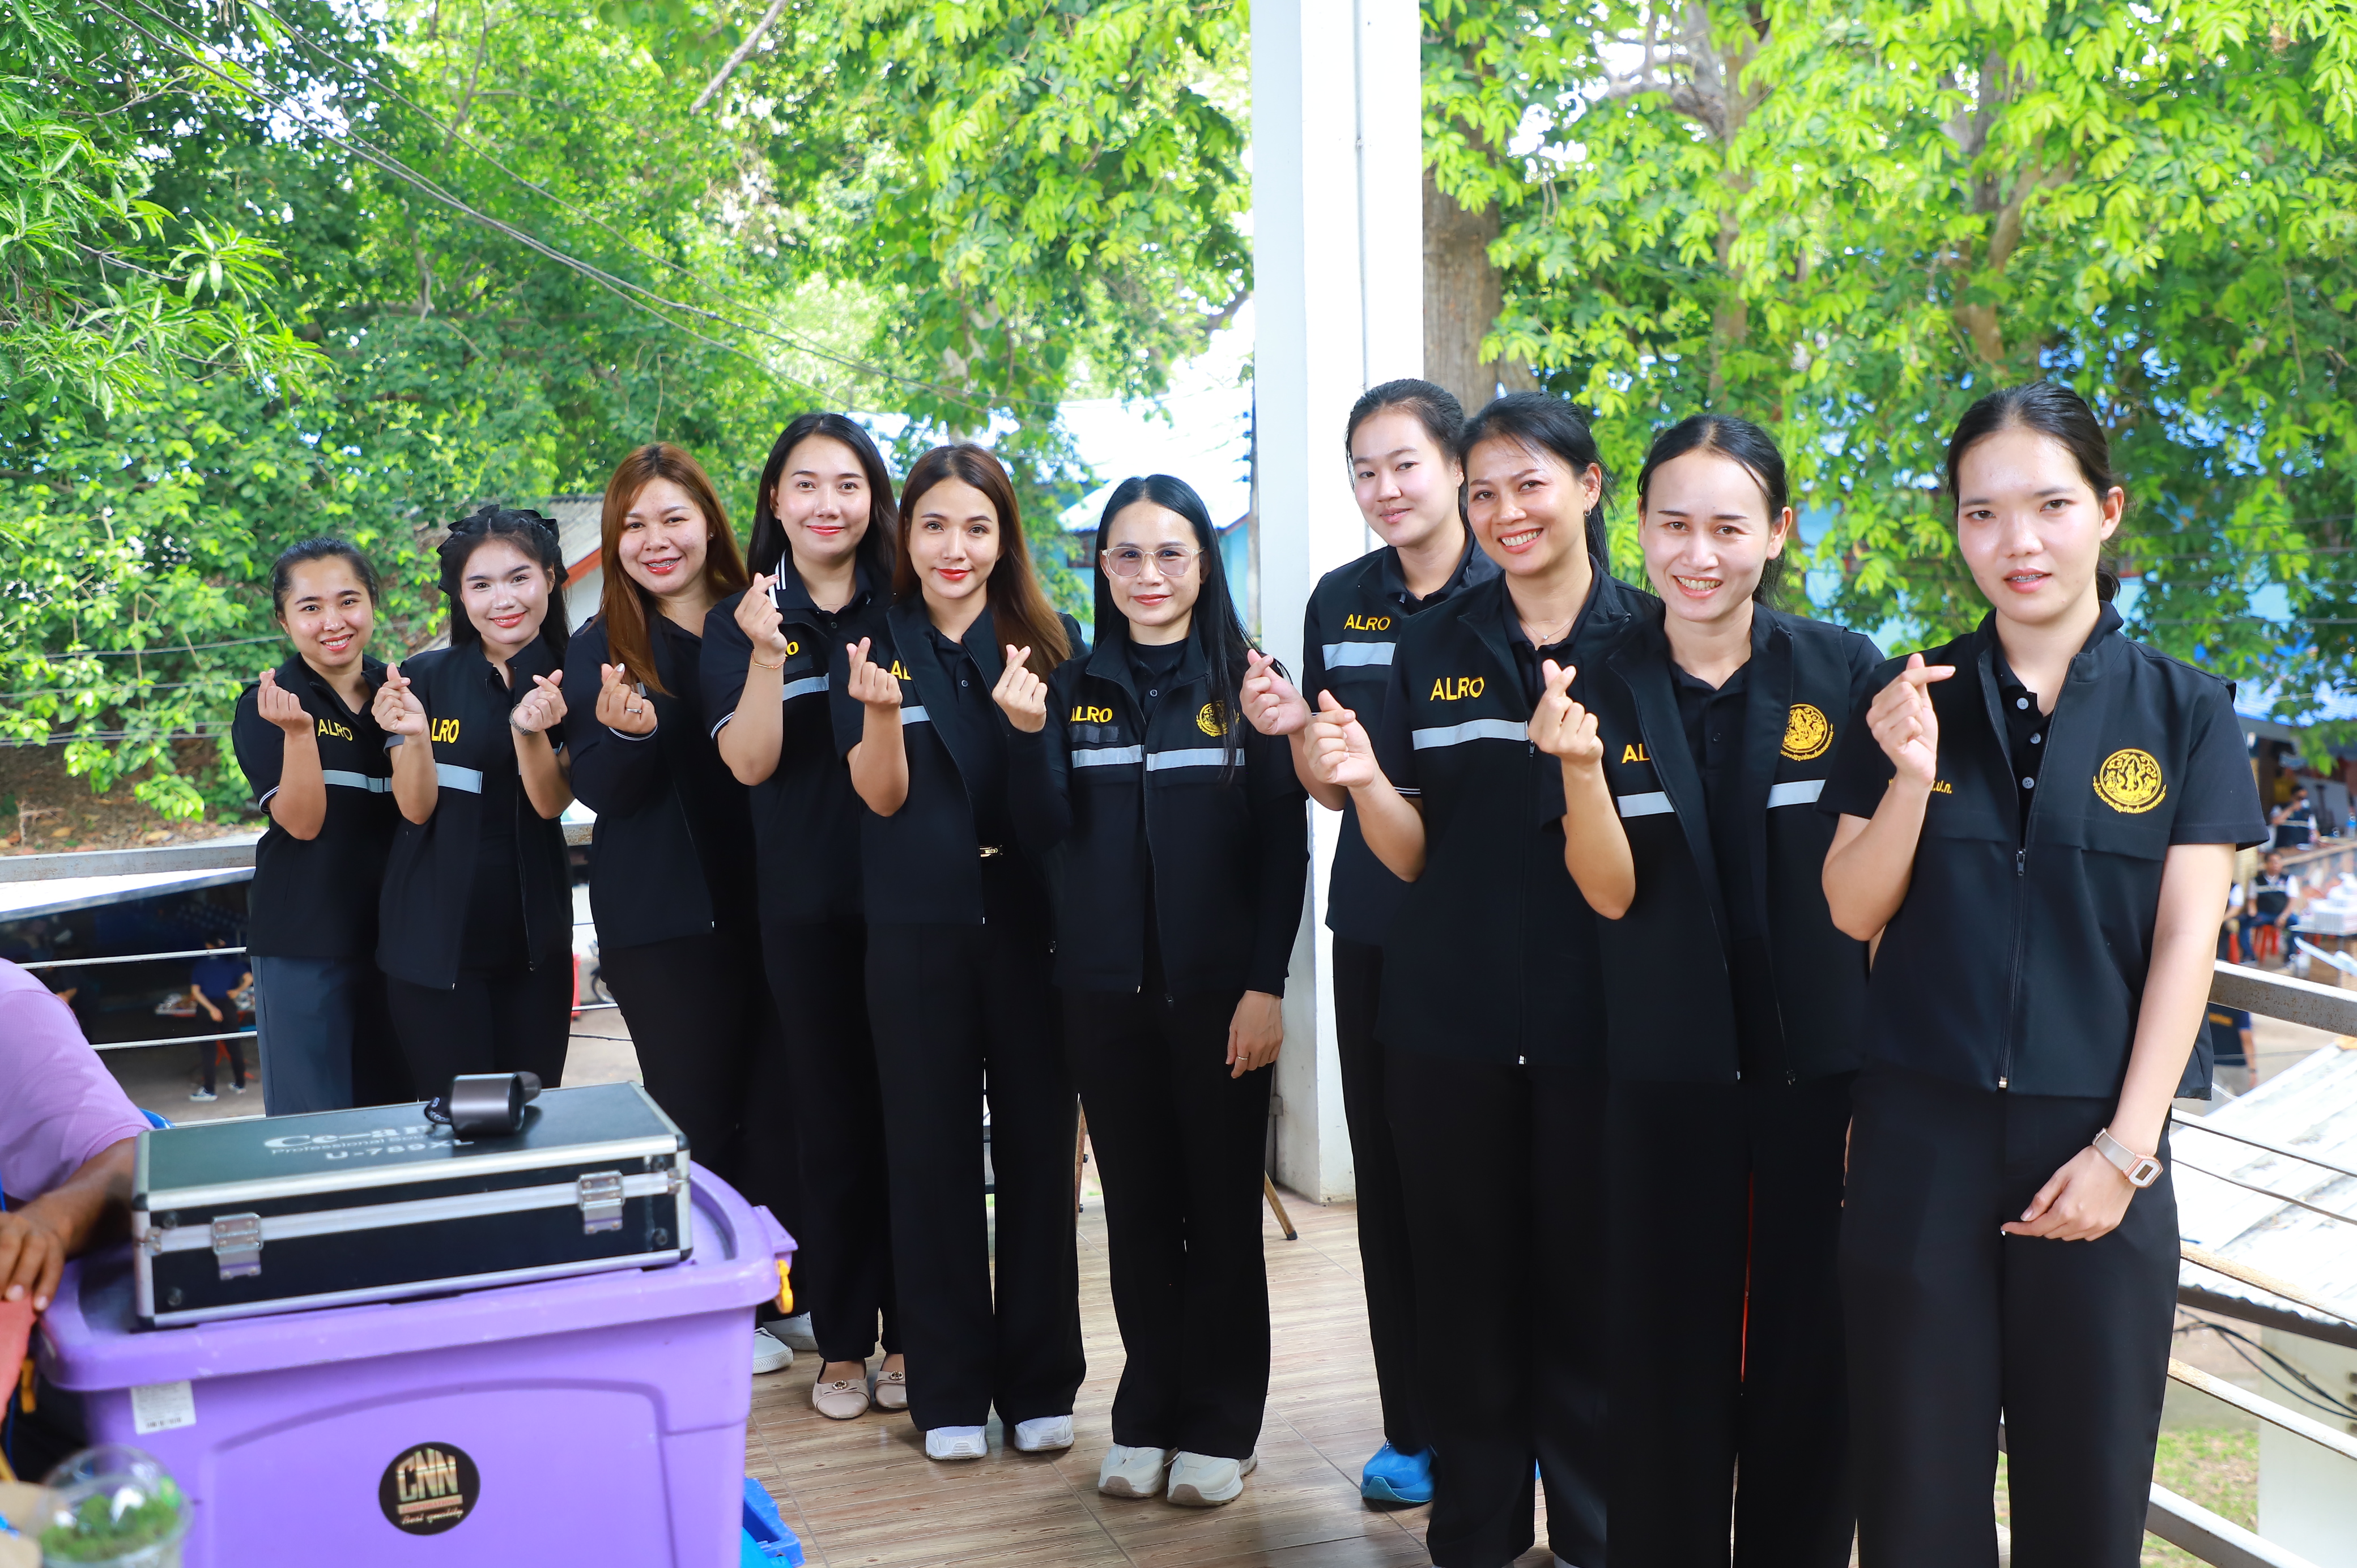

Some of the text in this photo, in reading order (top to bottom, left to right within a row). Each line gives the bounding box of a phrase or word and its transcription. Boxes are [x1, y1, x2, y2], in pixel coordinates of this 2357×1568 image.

[1344, 613, 1391, 631] ALRO
[891, 660, 912, 680] AL
[1429, 676, 1485, 701] ALRO
[317, 718, 353, 742] ALRO
[431, 718, 460, 744] LRO
[1622, 743, 1650, 764] AL
[396, 1447, 458, 1502] CNN
